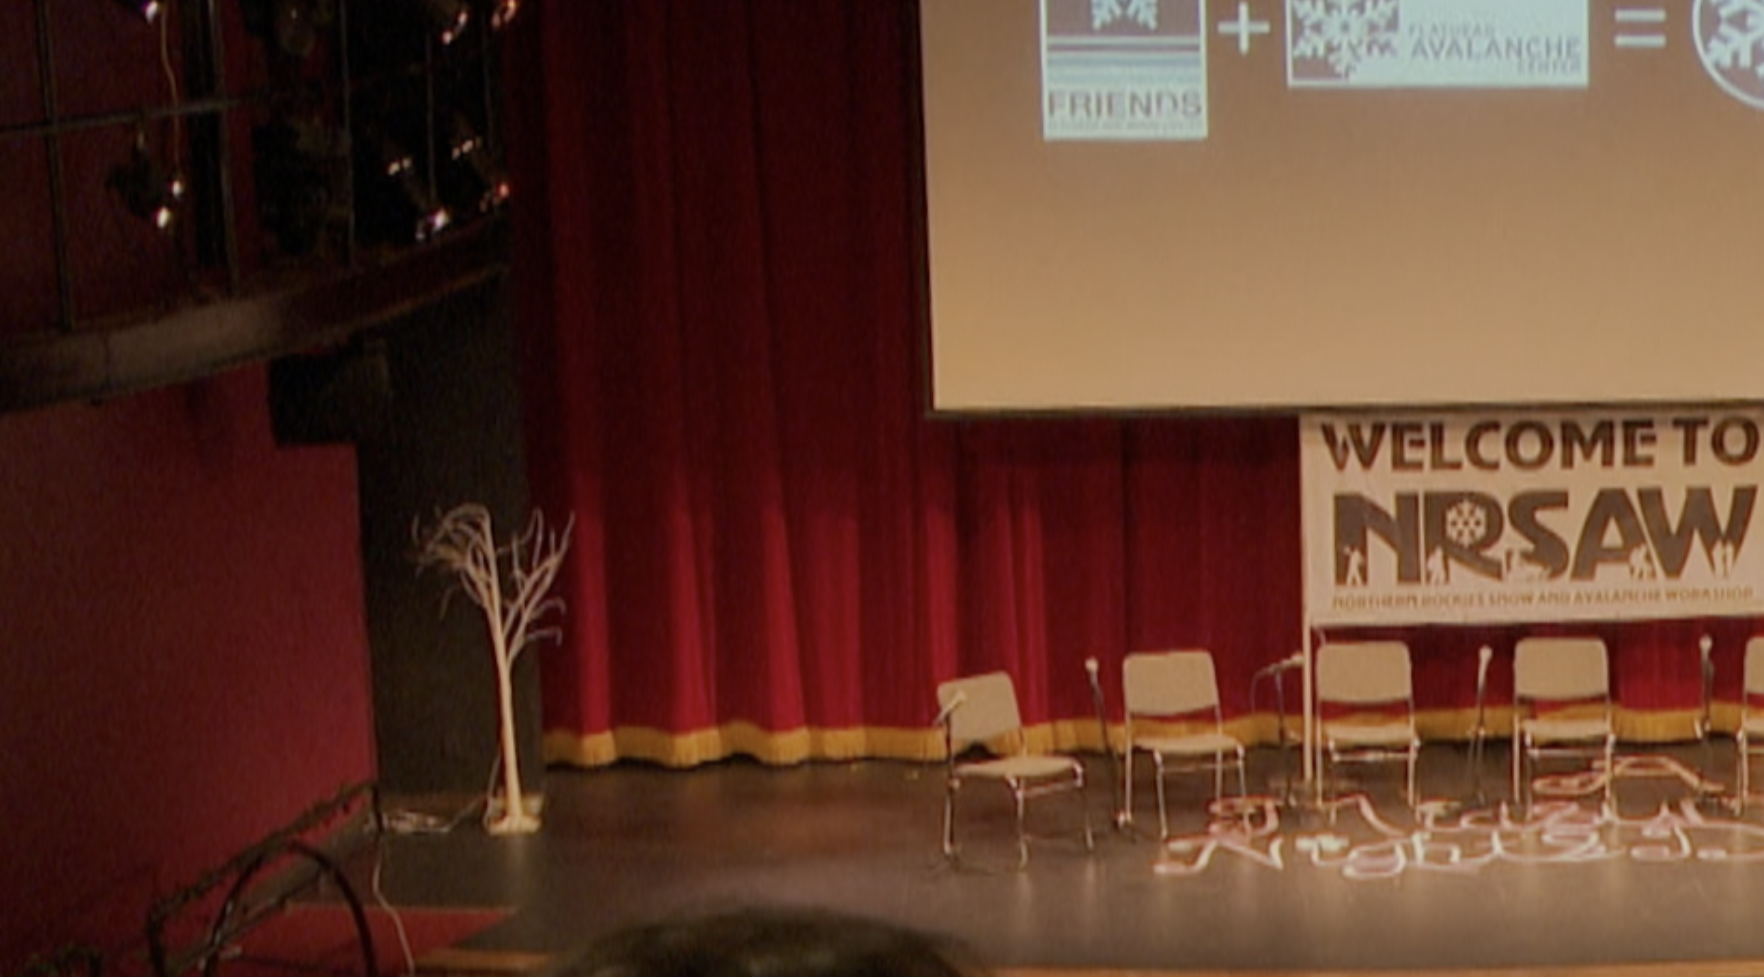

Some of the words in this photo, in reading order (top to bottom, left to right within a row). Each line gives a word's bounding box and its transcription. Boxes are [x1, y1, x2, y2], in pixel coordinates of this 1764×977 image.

[1411, 36, 1581, 61] AVALANCHE
[1048, 91, 1202, 118] FRIENDS
[1321, 420, 1658, 472] WELCOME
[1671, 416, 1760, 465] TO
[1333, 484, 1759, 587] NRSAW
[1332, 594, 1418, 611] NORTHERN
[1420, 593, 1485, 609] ROCKIES
[1488, 591, 1533, 606] SNOW
[1539, 589, 1570, 605] AND
[1573, 588, 1662, 604] AVALANCHE
[1664, 586, 1753, 602] WORKSHOP
